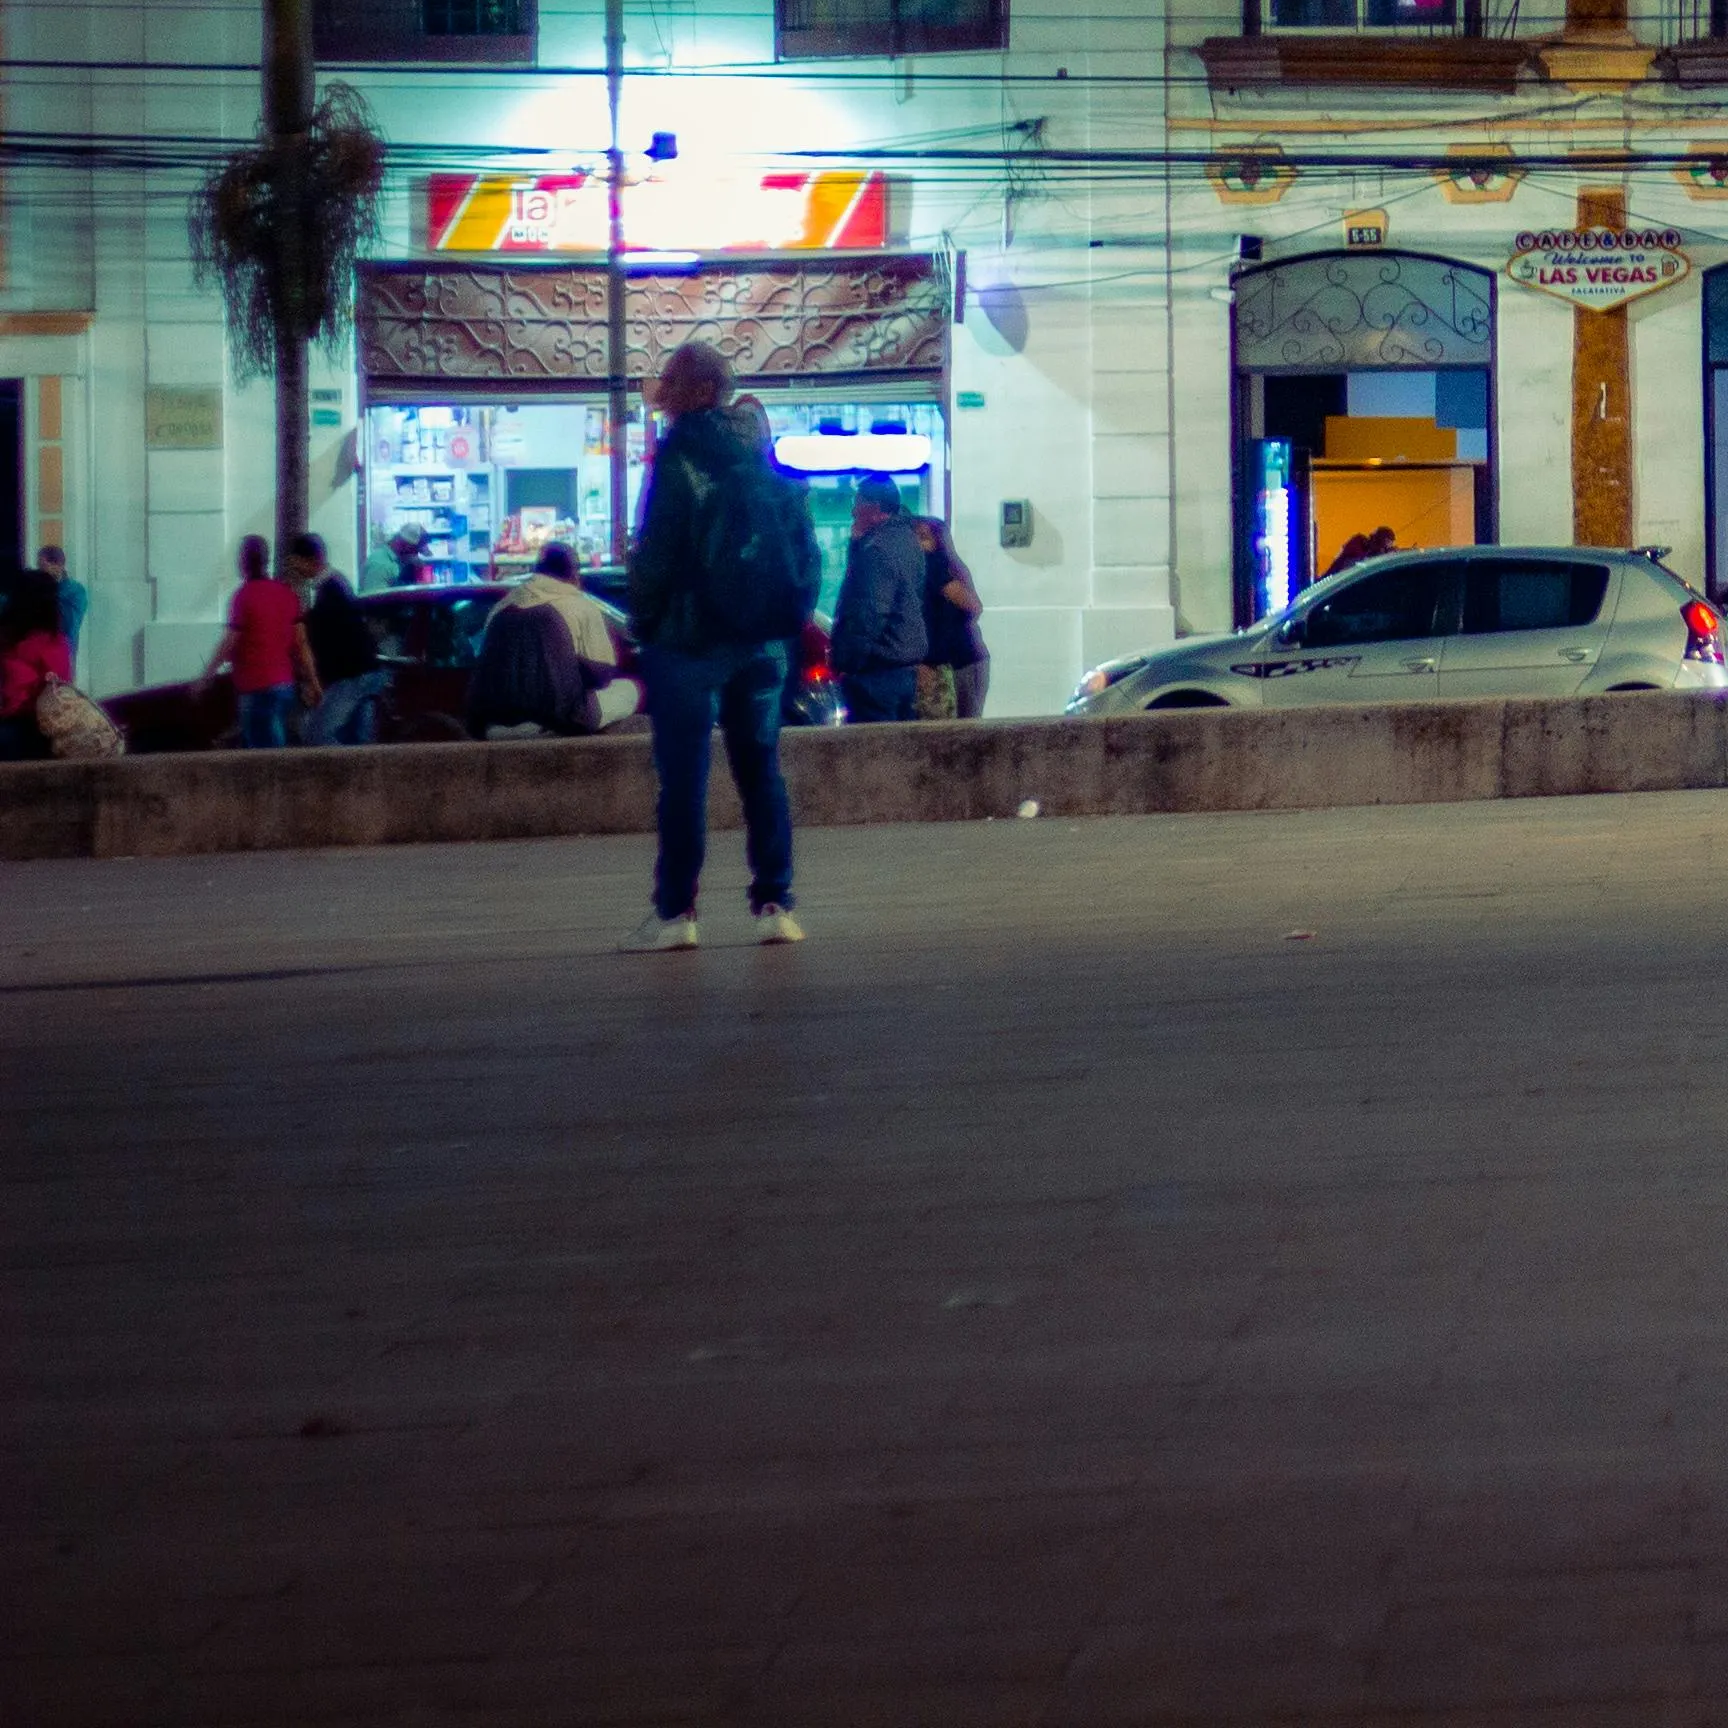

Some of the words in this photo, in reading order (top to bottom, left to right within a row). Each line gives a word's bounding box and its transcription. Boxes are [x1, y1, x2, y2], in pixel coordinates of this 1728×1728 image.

[1544, 251, 1623, 265] Welcome
[1539, 267, 1578, 284] LAS
[1585, 266, 1658, 284] VEGAS
